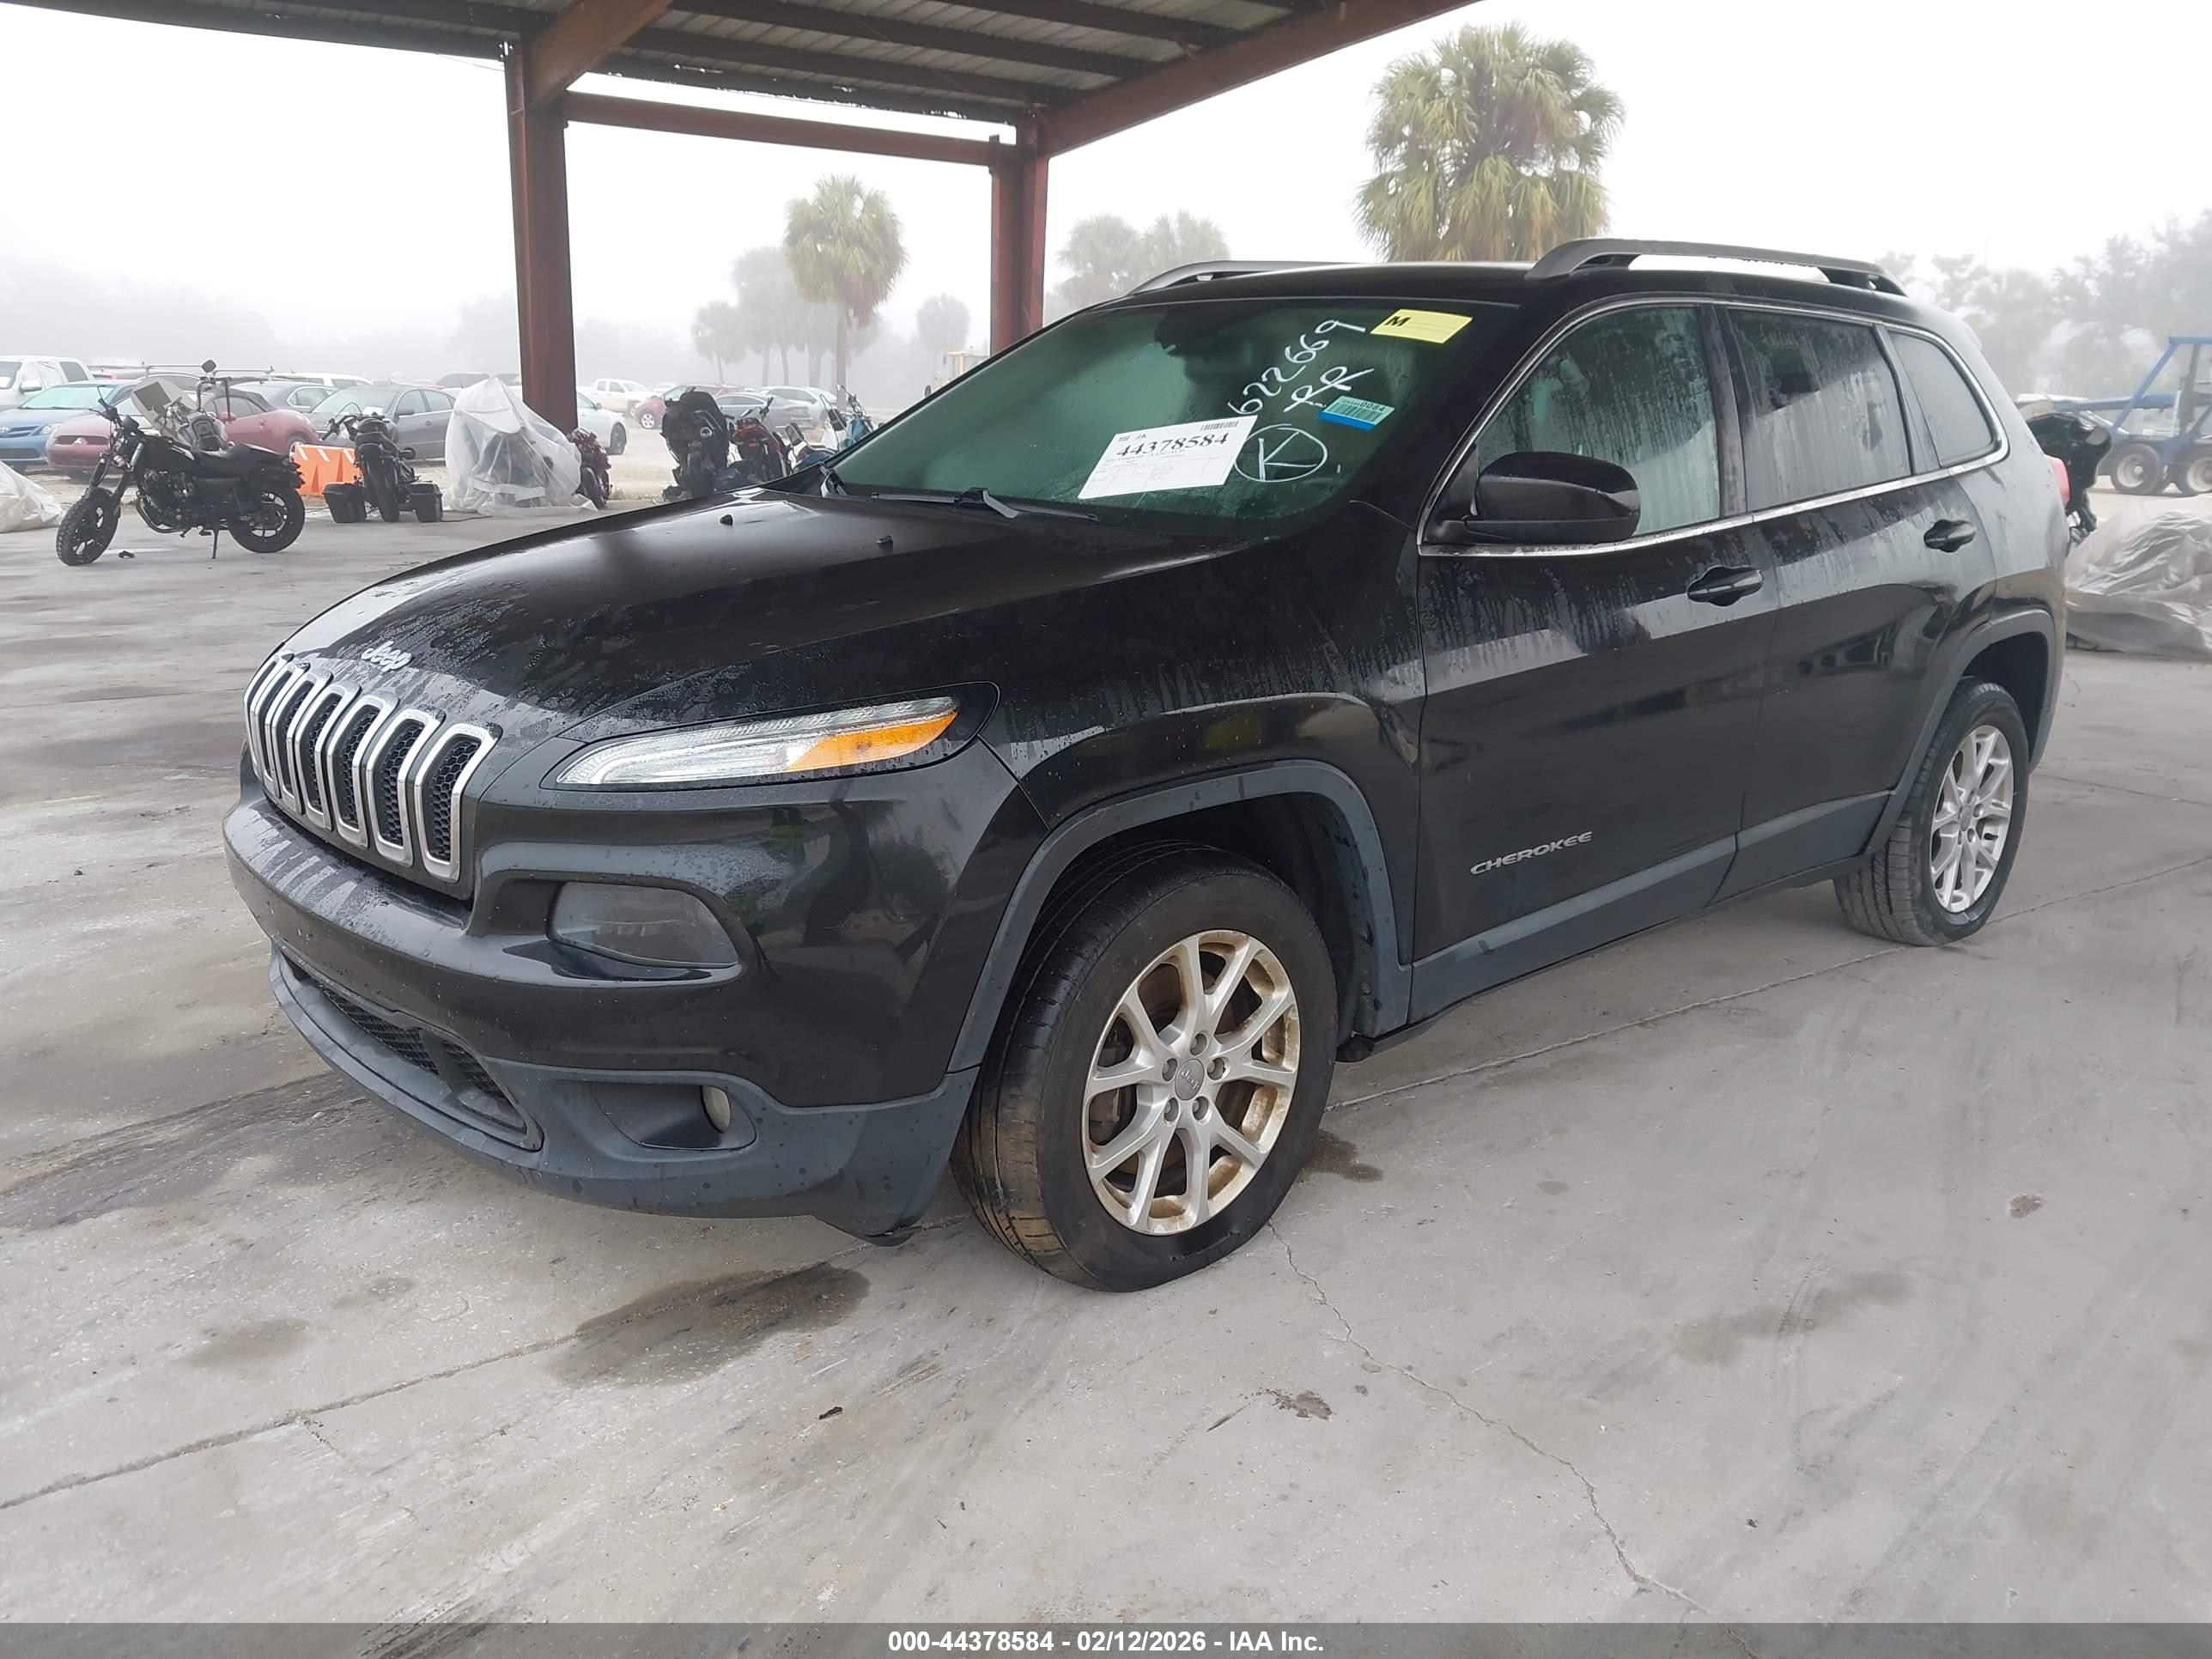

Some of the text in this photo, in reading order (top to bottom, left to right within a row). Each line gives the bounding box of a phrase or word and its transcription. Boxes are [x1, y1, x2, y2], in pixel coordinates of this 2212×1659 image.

[1384, 316, 1412, 327] M
[1227, 319, 1367, 415] 622669
[1116, 432, 1230, 457] 44378584
[362, 640, 412, 672] Jeep
[1469, 831, 1594, 876] CHEROKEE
